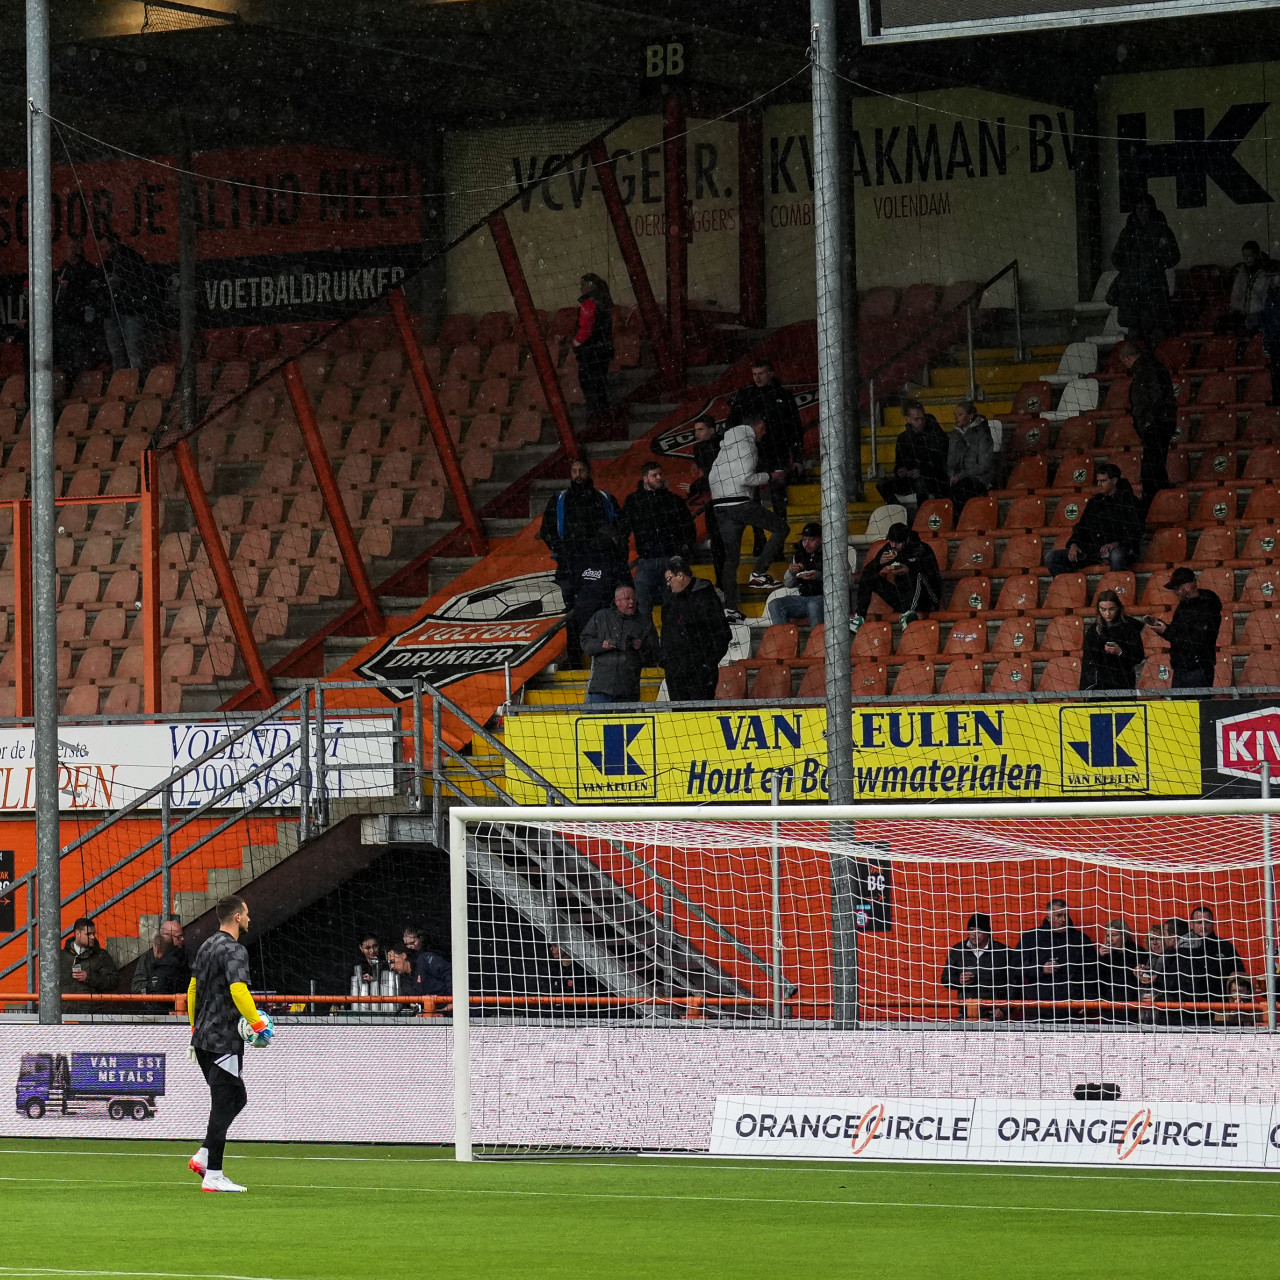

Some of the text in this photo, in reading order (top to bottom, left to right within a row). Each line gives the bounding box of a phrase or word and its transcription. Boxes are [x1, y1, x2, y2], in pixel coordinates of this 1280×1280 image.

[645, 42, 686, 78] BB
[873, 191, 951, 221] VOLENDAM
[393, 647, 515, 668] DRUKKER
[716, 709, 1005, 751] VAN EULEN
[11, 740, 26, 760] de
[687, 759, 751, 796] Hout
[800, 754, 1042, 795] Bowmaterialen
[1067, 774, 1090, 785] VAN
[582, 781, 648, 792] VAN KEULEN
[90, 1056, 162, 1069] VAN EST
[98, 1070, 155, 1083] METALS
